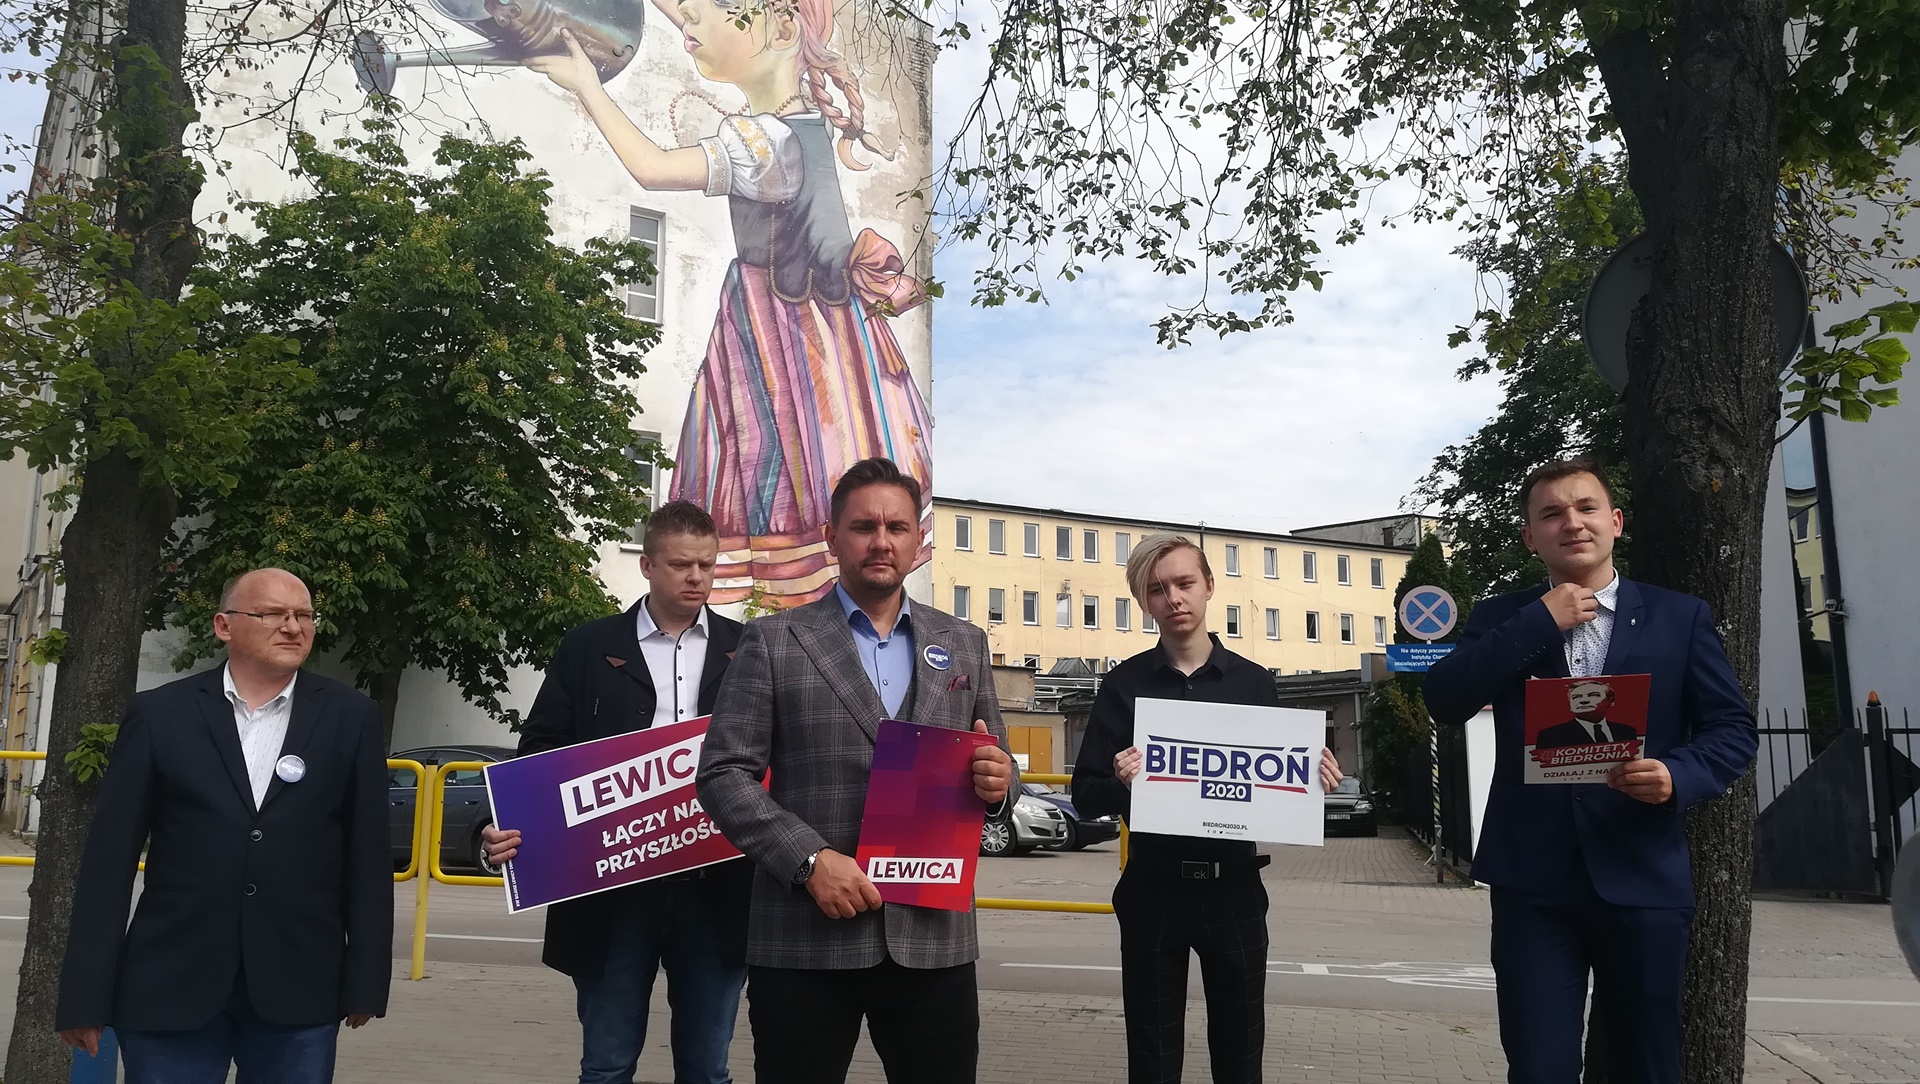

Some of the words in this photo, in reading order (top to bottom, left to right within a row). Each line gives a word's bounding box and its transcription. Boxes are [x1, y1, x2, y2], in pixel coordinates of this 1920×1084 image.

[1145, 744, 1310, 785] BIEDROŃ
[1550, 750, 1631, 765] BIEDRONIA
[572, 741, 704, 816] LEWIC
[1543, 770, 1585, 778] DZIAŁAJ
[1205, 783, 1247, 800] 2020
[601, 808, 668, 849] ŁĄCZY
[1202, 821, 1248, 831] BIEDRON2020.PL
[872, 861, 957, 880] LEWICA
